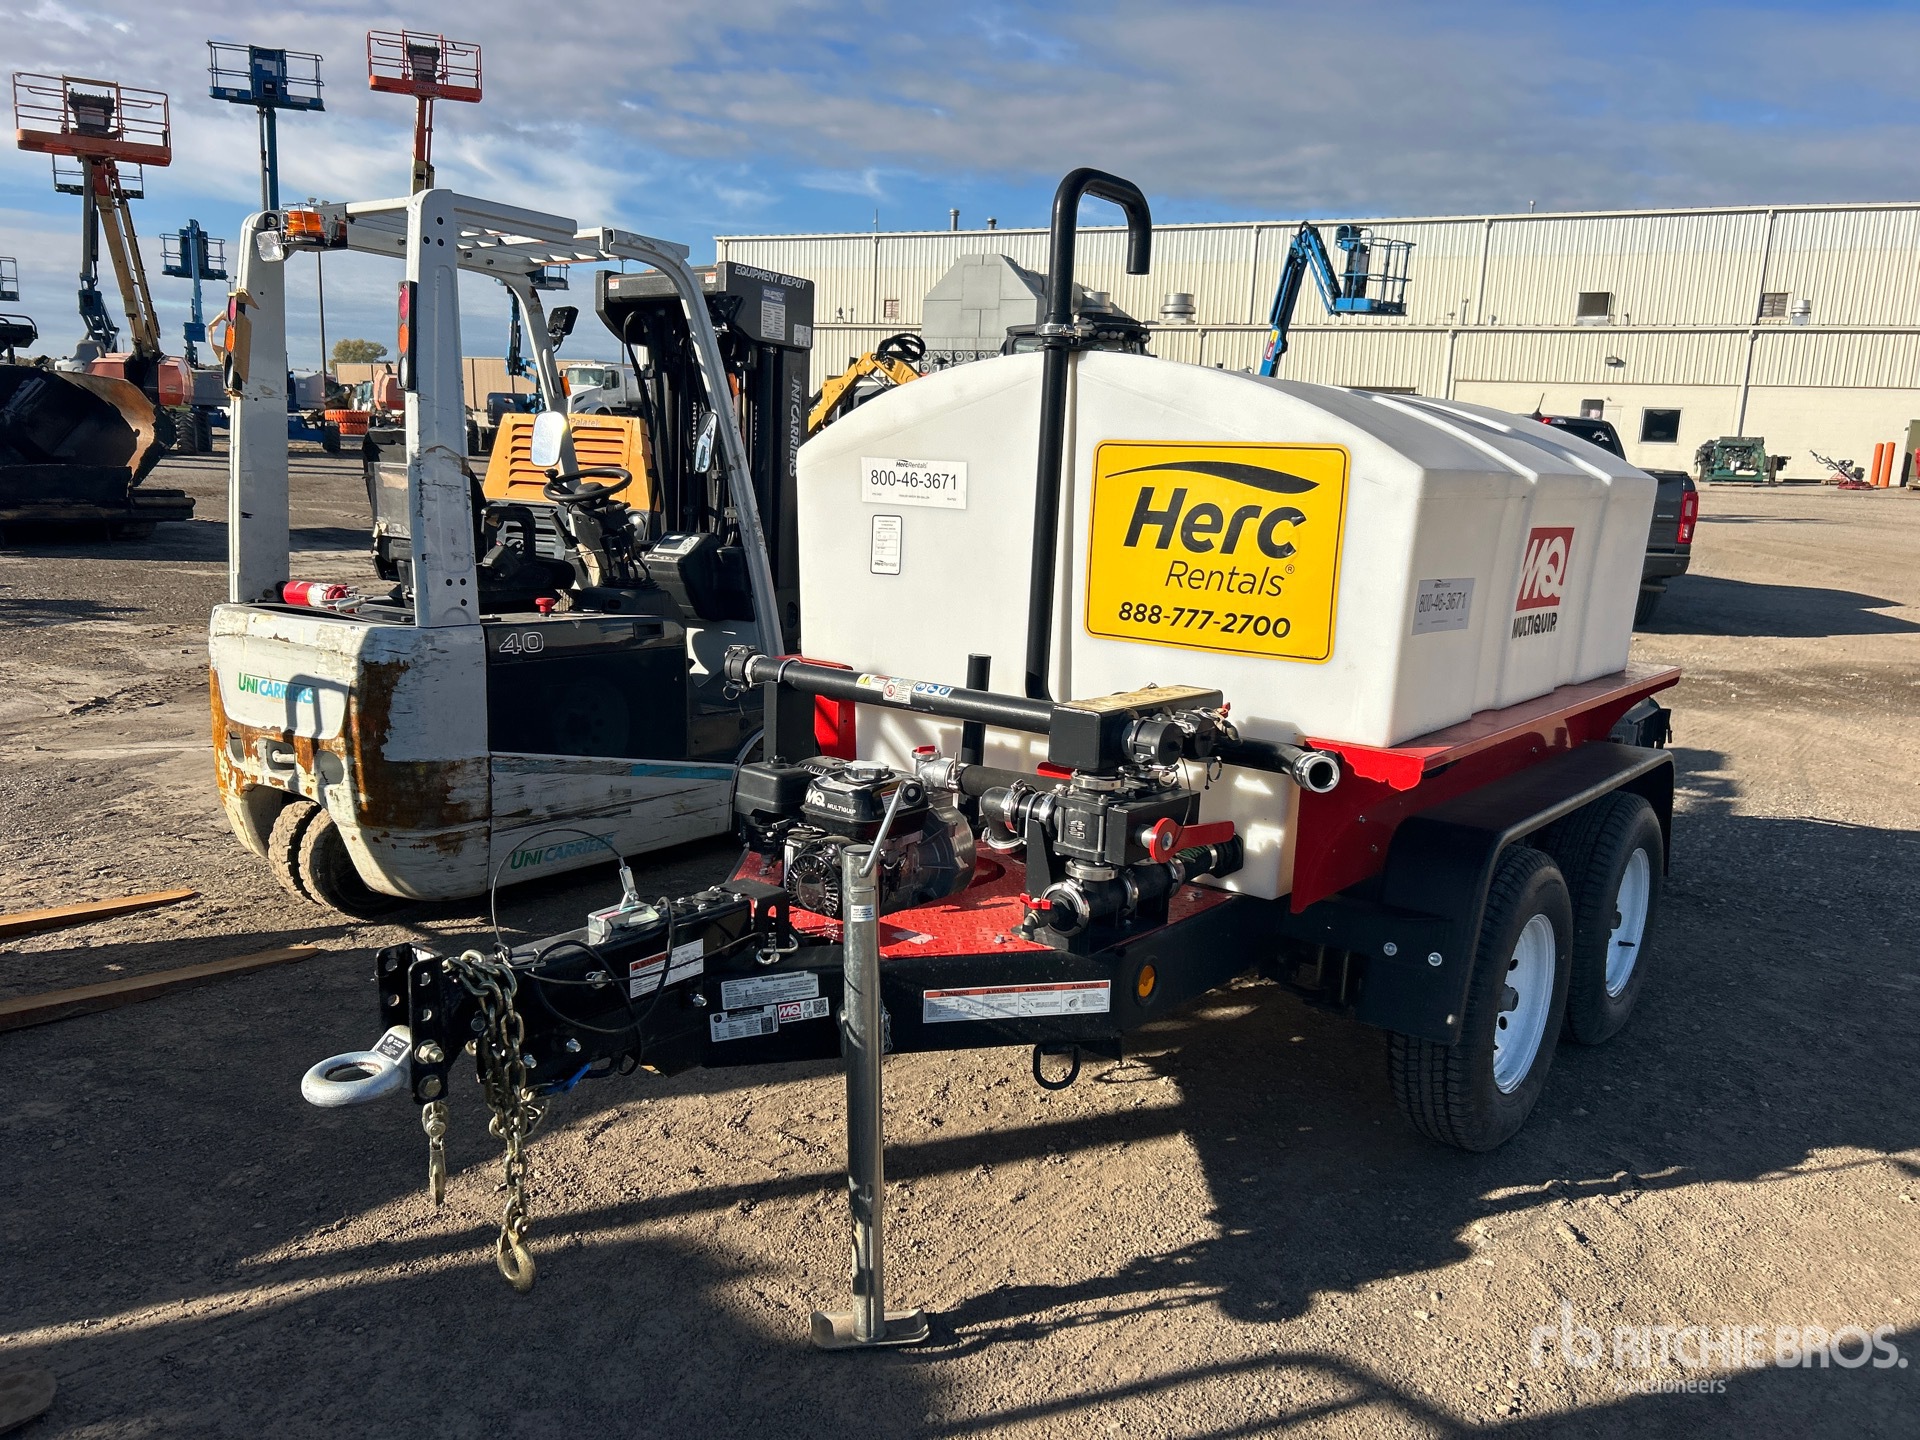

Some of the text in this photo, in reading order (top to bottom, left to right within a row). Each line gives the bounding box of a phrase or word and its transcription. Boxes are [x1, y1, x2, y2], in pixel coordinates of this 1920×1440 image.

[735, 265, 806, 290] EQUIPMENT DEPOT
[871, 469, 956, 490] 800-46-3671
[1123, 486, 1307, 559] Herc
[1520, 536, 1567, 600] MQ
[1118, 601, 1291, 639] 888-777-2700
[1511, 612, 1557, 639] MULTIQUIP
[499, 631, 544, 654] 40
[805, 788, 857, 814] MQ MULTIQUIP
[779, 1004, 801, 1017] MQ
